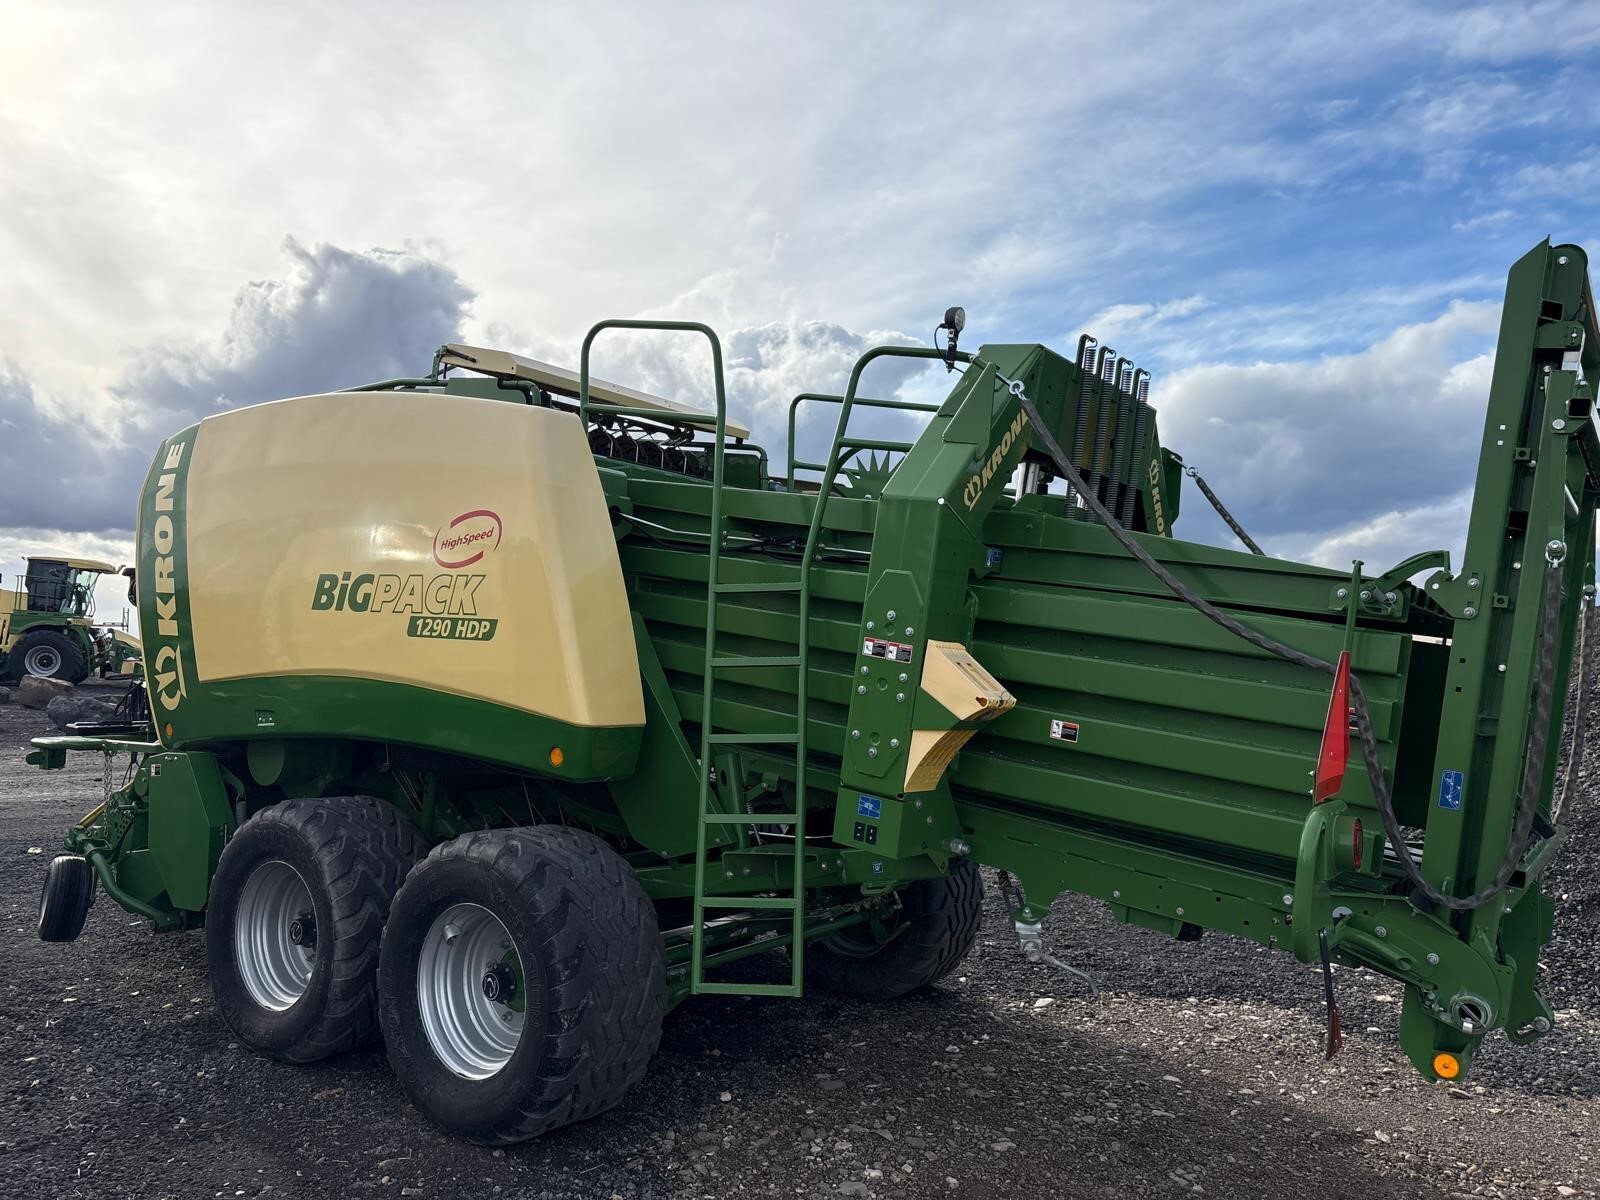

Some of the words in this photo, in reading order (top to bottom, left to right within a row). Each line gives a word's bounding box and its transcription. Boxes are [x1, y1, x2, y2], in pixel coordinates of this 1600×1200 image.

[154, 441, 186, 636] KRONE
[440, 526, 495, 550] HighSpeed
[416, 619, 450, 637] 1290
[455, 620, 491, 639] HDP
